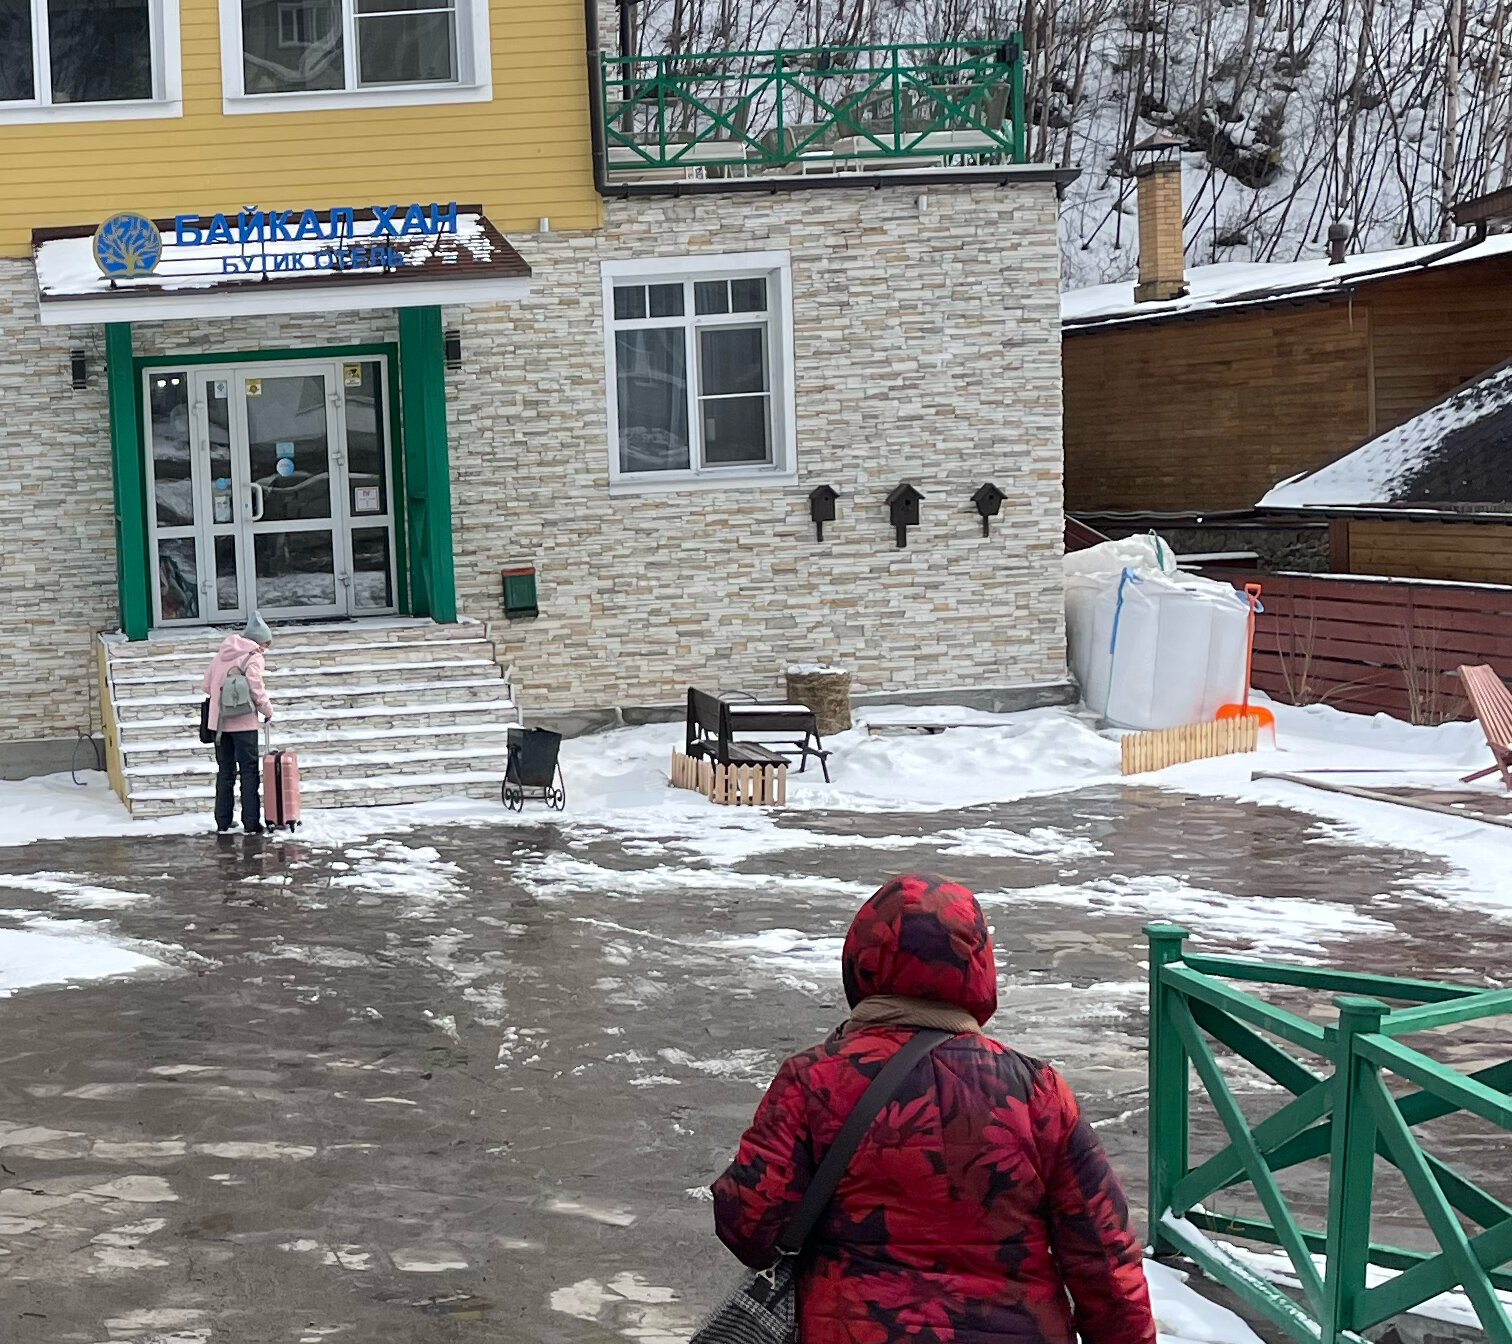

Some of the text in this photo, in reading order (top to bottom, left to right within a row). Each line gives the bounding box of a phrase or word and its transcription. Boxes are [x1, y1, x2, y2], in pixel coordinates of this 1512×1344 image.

[175, 202, 457, 246] БАЙКАЛ ХАН
[222, 246, 404, 274] БУТИК ОТЕЛЬ
